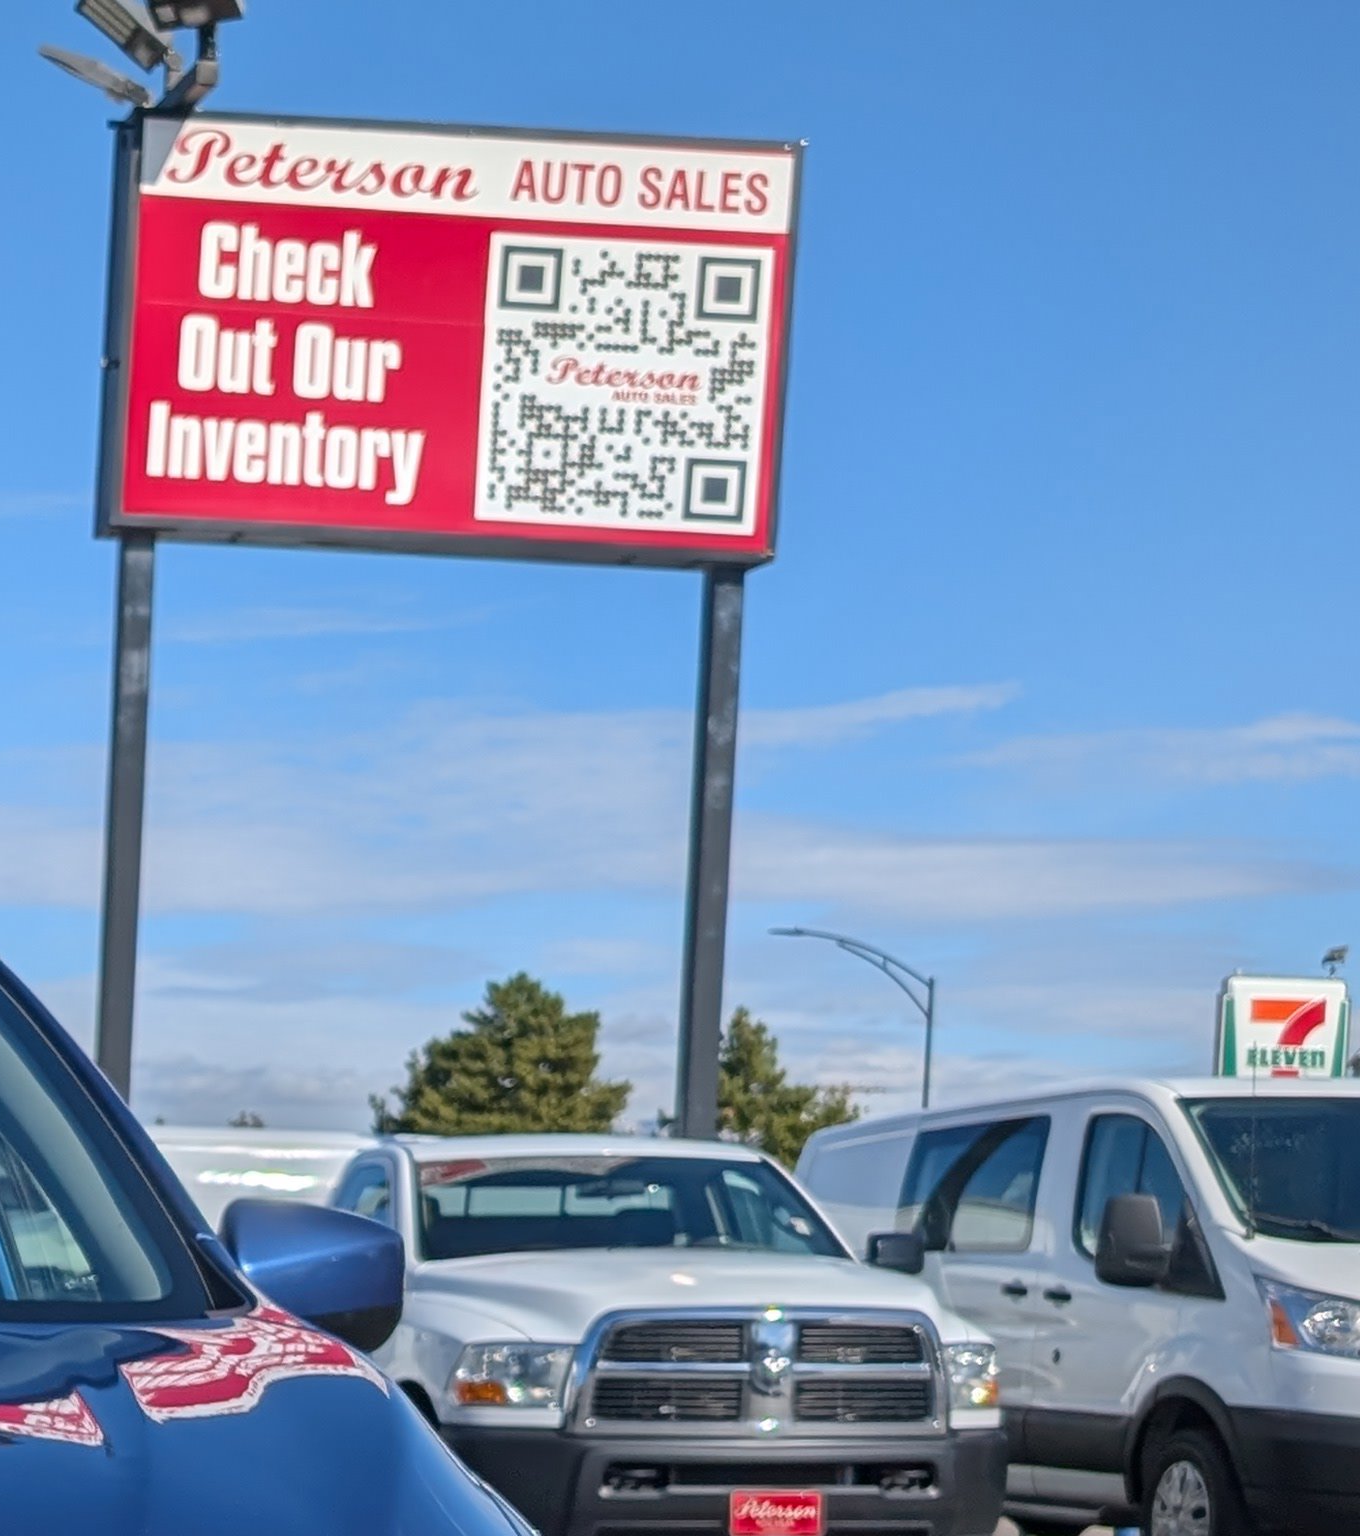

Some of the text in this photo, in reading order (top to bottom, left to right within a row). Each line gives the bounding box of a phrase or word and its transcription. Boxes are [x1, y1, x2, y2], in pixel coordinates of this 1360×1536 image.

[167, 129, 771, 214] Peterson AUTO SALES
[197, 220, 378, 308] Check
[177, 314, 402, 404] Out Our
[545, 354, 702, 391] Peterson
[612, 390, 697, 405] AUTO SALES
[145, 401, 425, 506] Inventory
[1251, 999, 1326, 1045] 7
